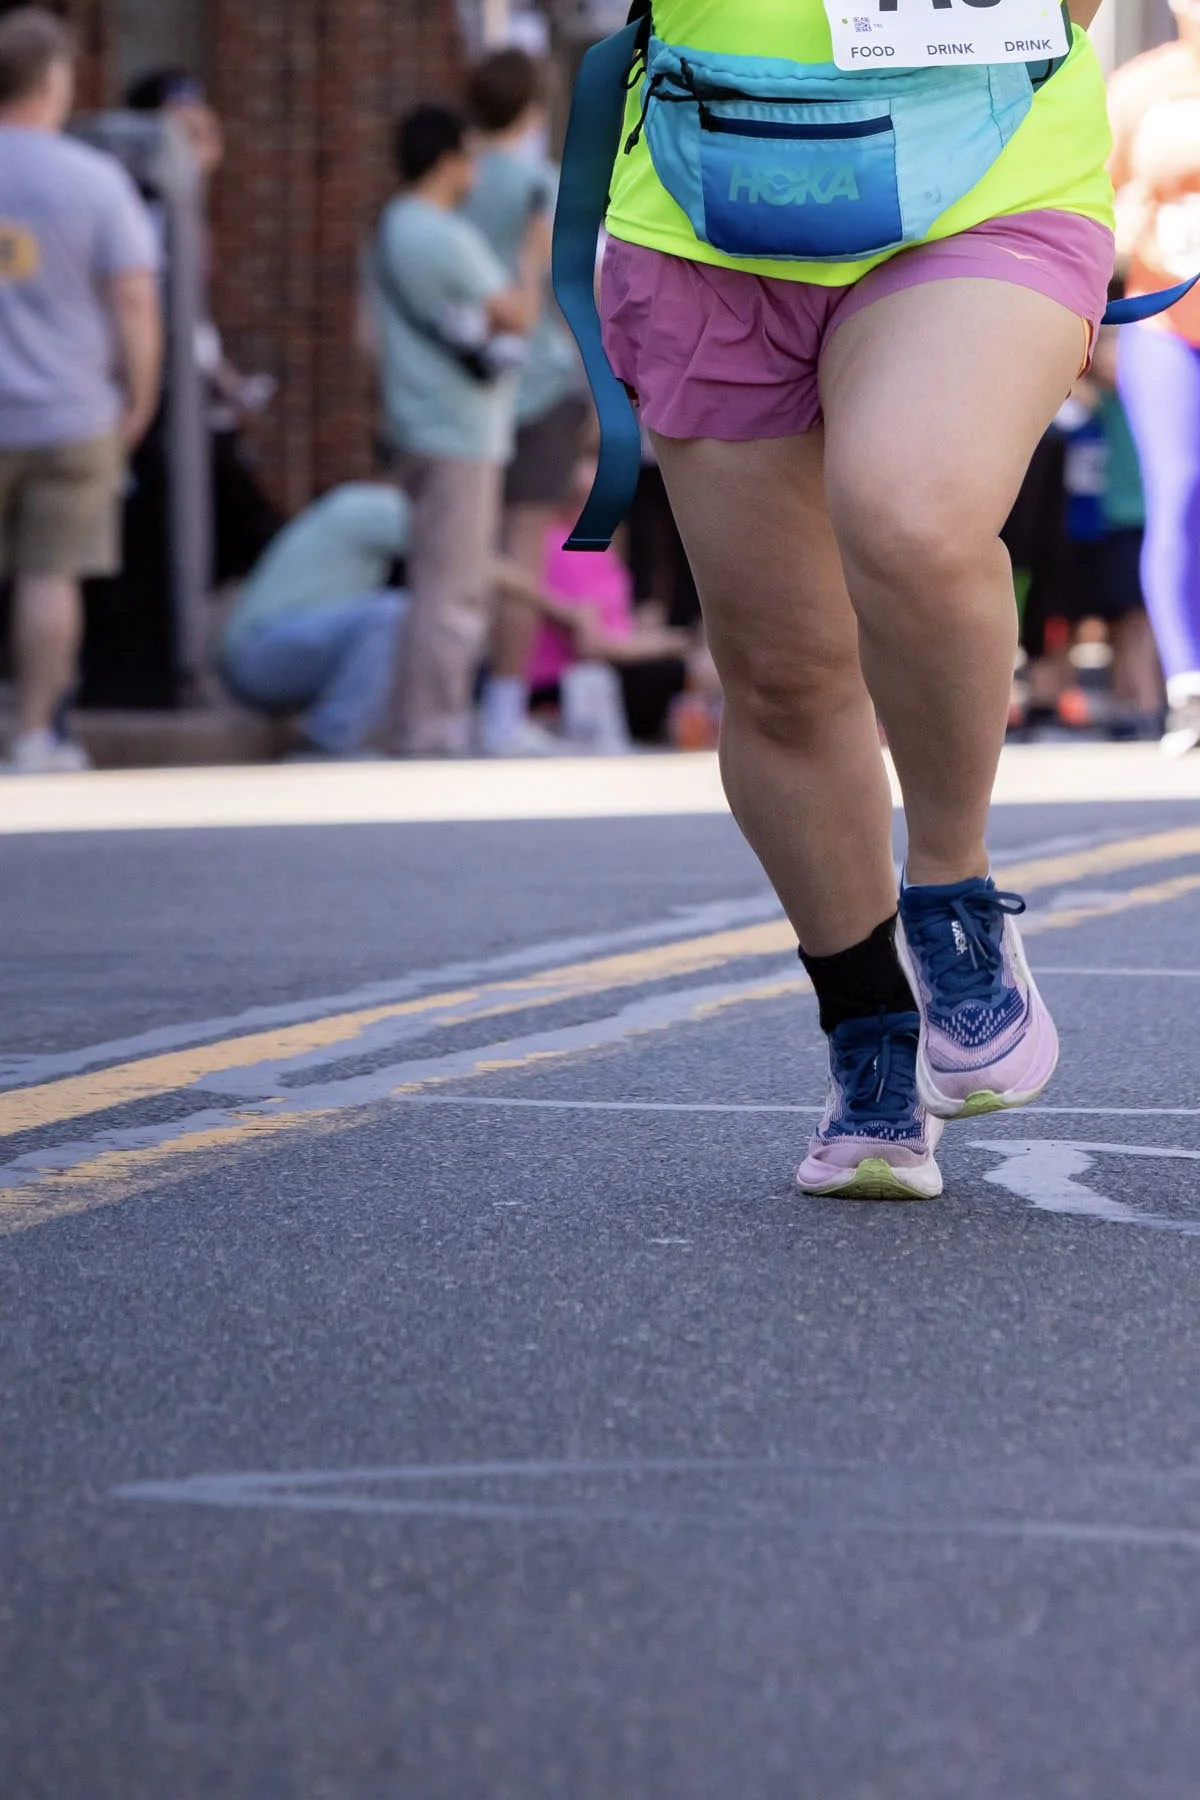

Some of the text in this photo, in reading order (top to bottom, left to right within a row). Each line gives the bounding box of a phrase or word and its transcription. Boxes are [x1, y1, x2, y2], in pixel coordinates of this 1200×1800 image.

[850, 38, 1053, 60] FOOD DRINK DRINK
[728, 161, 860, 206] HOKA
